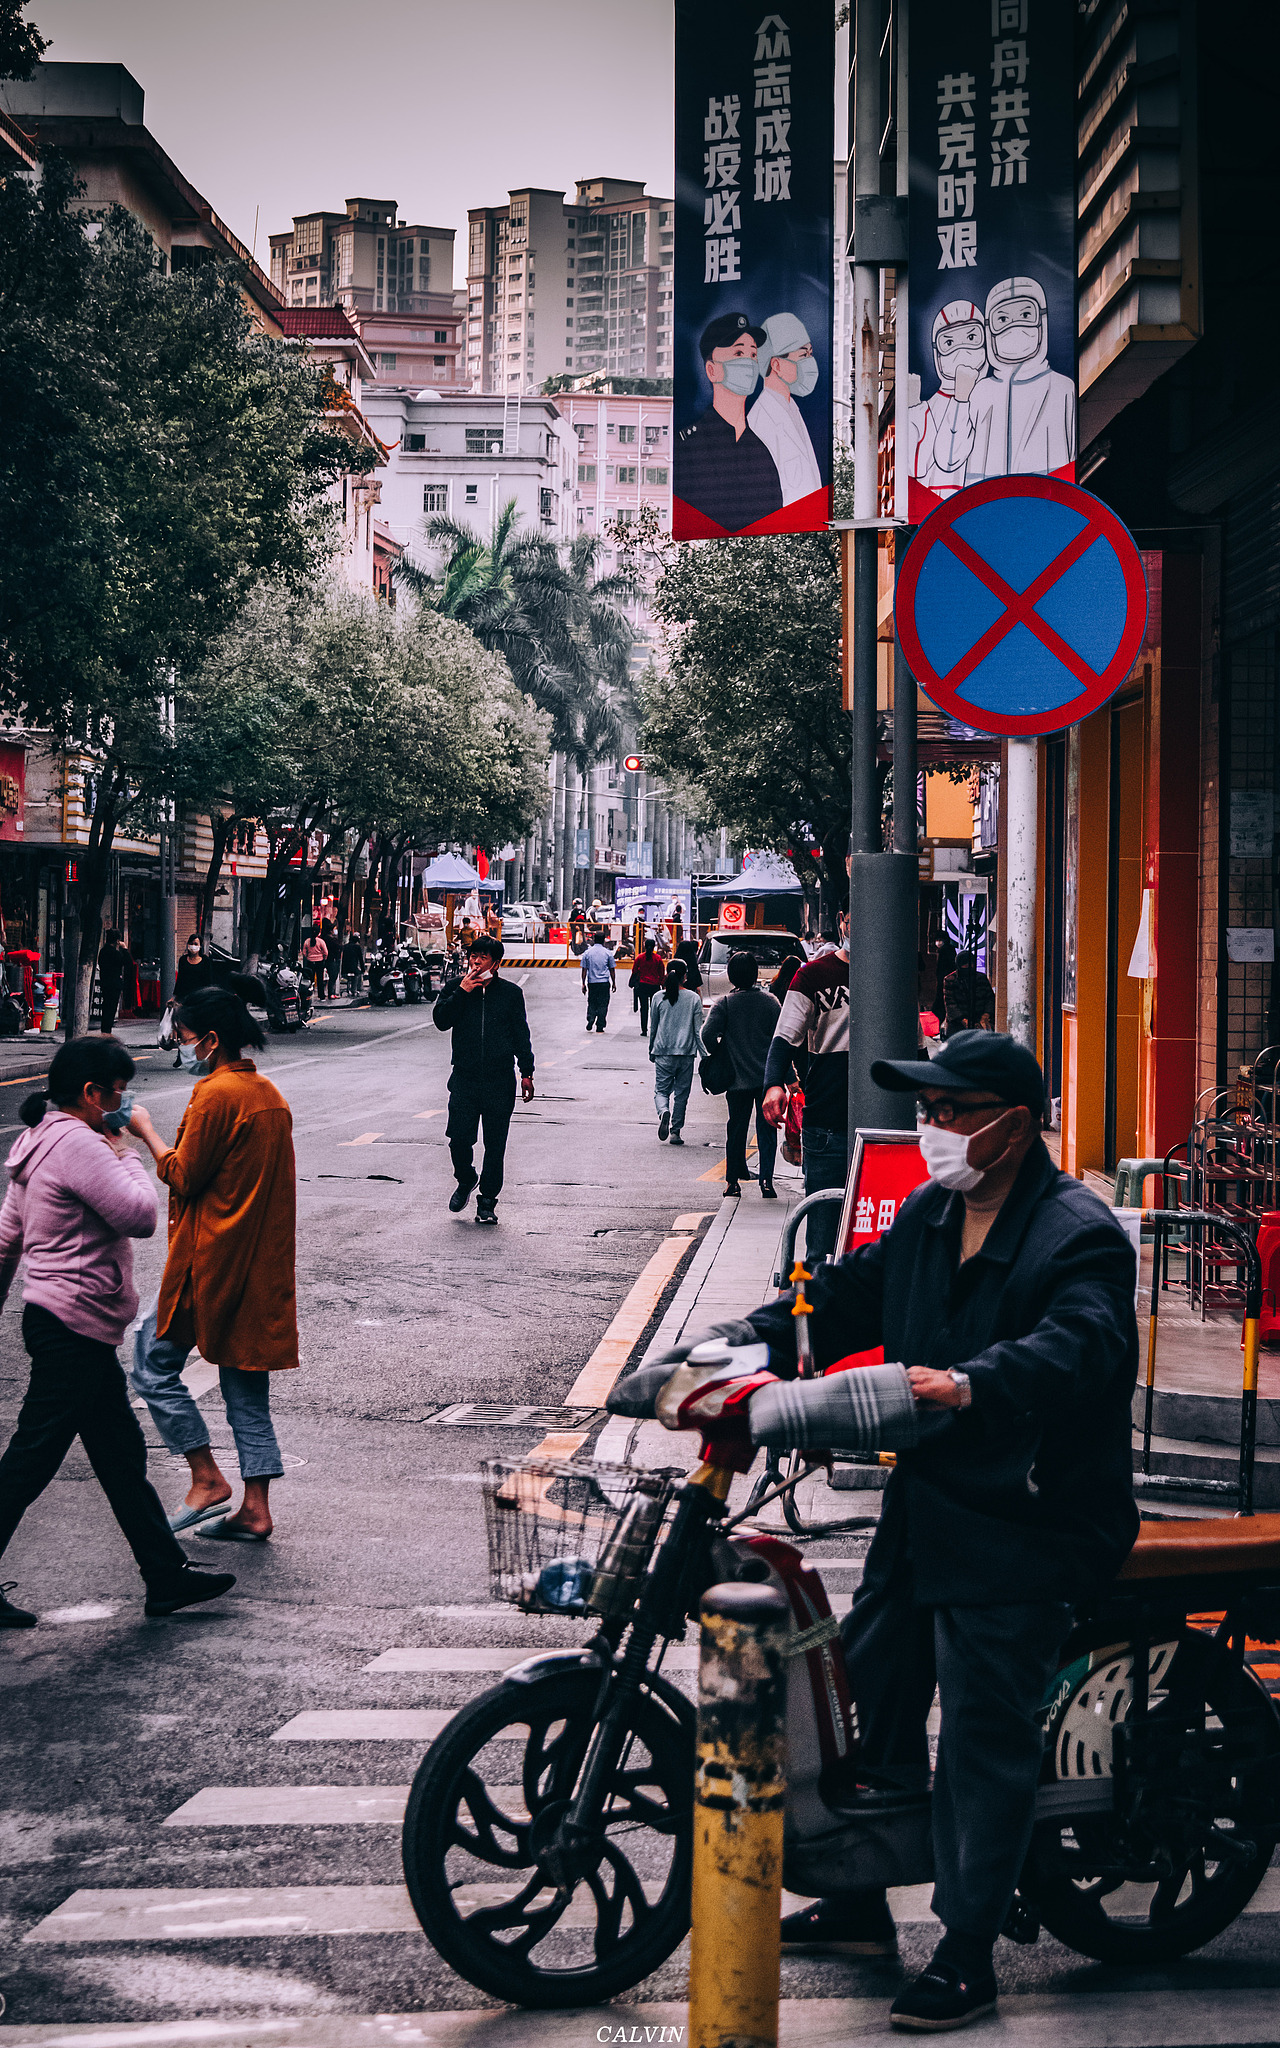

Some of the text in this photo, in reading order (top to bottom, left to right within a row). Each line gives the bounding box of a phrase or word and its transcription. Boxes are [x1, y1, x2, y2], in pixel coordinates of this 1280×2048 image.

[754, 14, 791, 202] 众志成城
[937, 72, 977, 270] 共克时艰
[990, 0, 1030, 188] 同舟共济
[704, 94, 741, 283] 战疫必胜
[853, 1196, 906, 1232] 盐田
[831, 1689, 845, 1729] POWER
